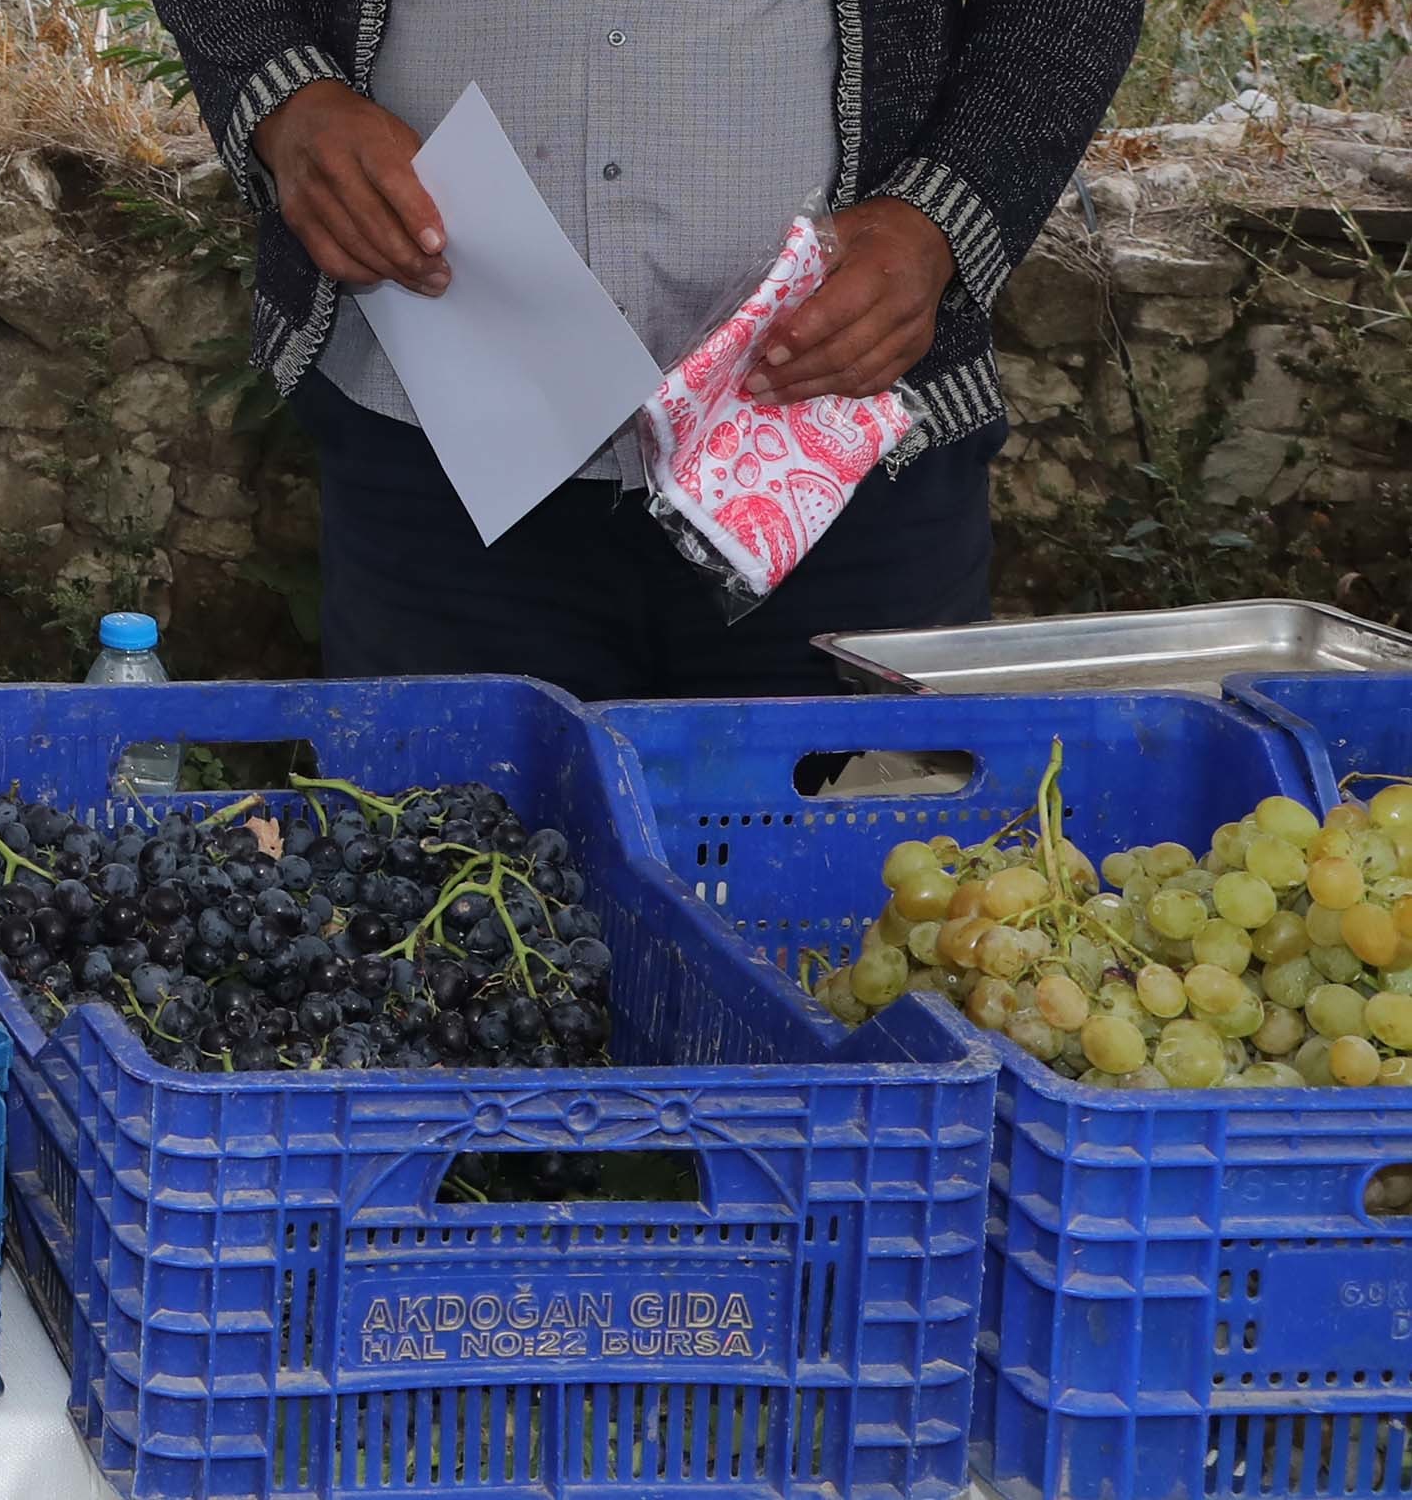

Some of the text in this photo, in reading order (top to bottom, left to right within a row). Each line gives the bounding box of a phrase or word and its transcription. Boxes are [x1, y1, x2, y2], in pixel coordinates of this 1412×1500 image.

[361, 1283, 754, 1333] AKDOĞAN GIDA
[361, 1332, 447, 1362] HAL
[600, 1329, 754, 1358] BURSA
